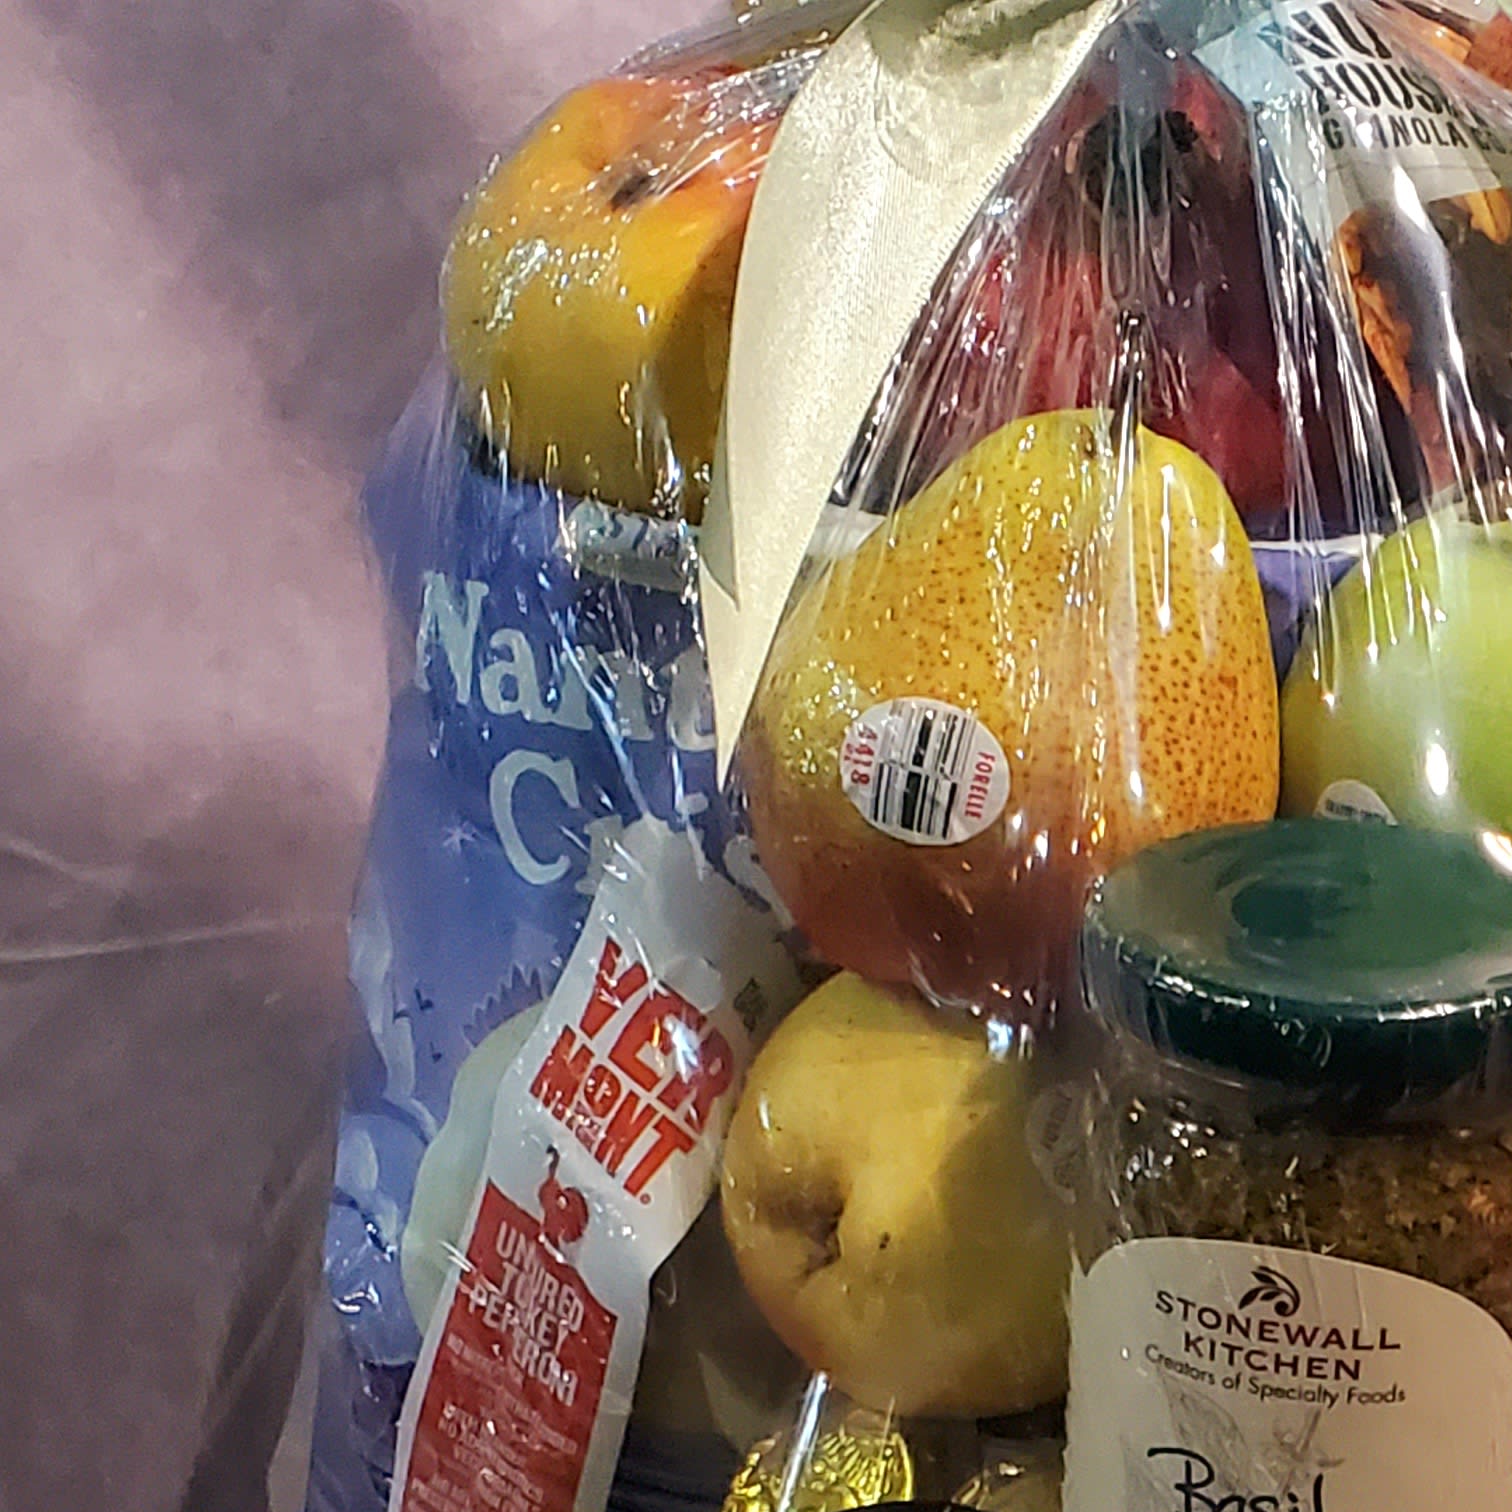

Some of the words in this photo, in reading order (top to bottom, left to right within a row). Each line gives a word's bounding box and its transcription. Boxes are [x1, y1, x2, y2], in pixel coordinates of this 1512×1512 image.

[1323, 113, 1469, 150] GANOLA
[1154, 1289, 1402, 1351] STONEWALL
[1144, 1343, 1216, 1386] Creators
[1221, 1372, 1243, 1391] of
[1249, 1377, 1340, 1410] Specialty
[1347, 1383, 1406, 1405] Foods
[1182, 1331, 1362, 1381] KITCHEN
